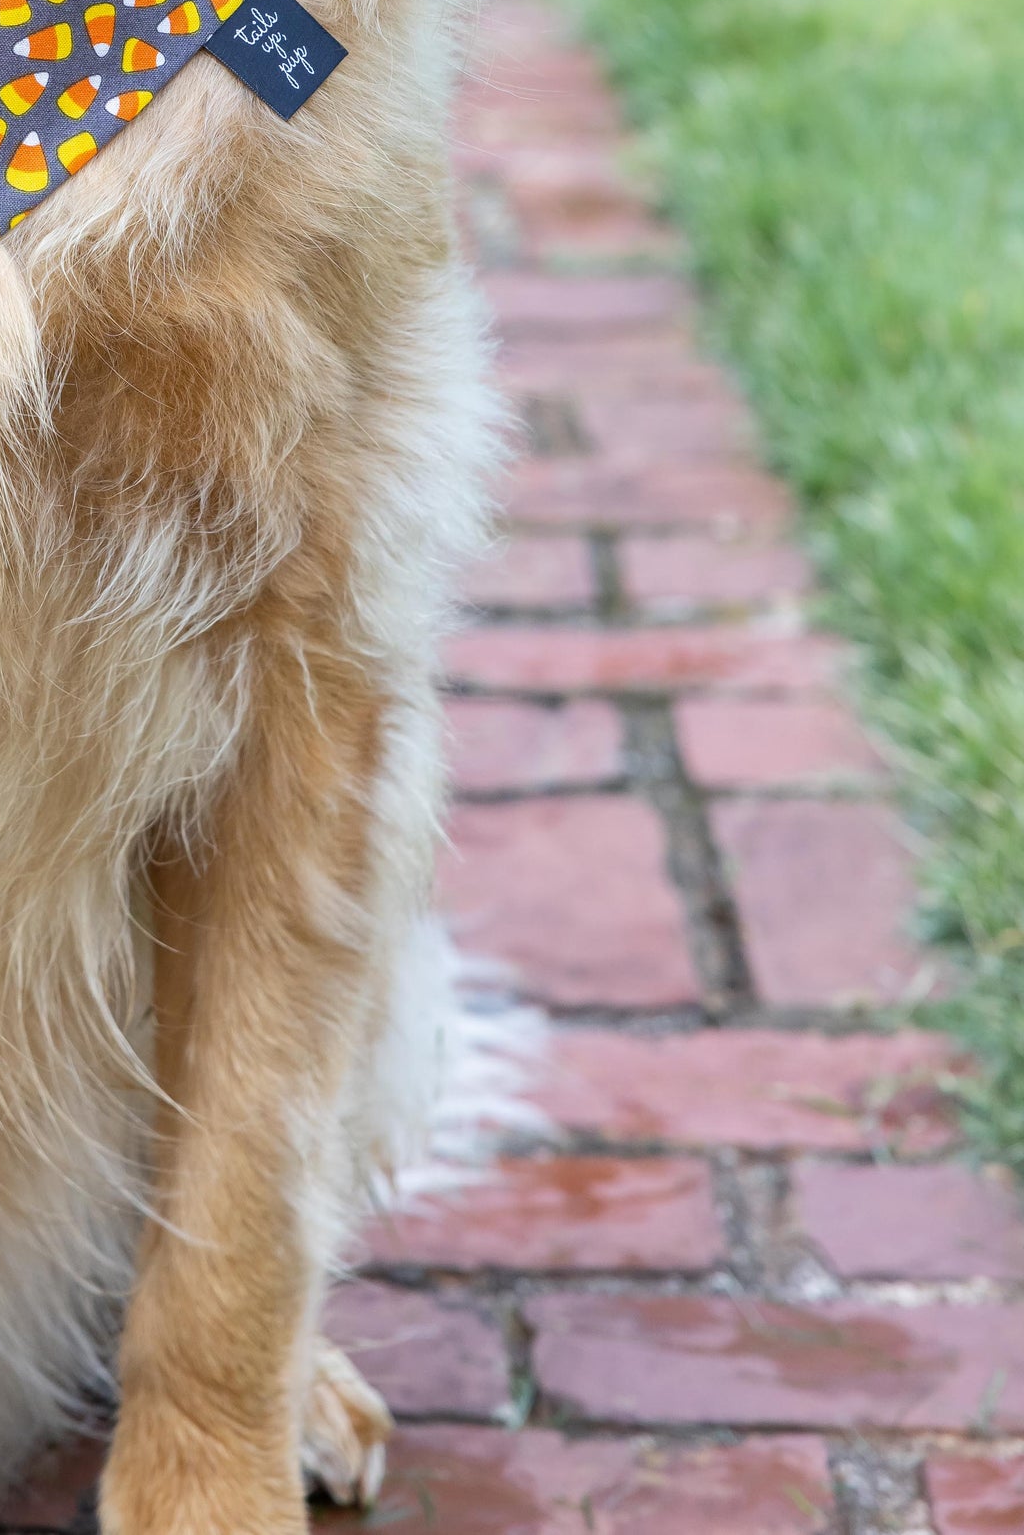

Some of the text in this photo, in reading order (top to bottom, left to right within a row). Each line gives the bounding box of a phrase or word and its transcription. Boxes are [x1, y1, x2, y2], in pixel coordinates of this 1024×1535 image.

[233, 7, 278, 45] tails
[261, 32, 287, 59] up,
[278, 45, 315, 90] pup
